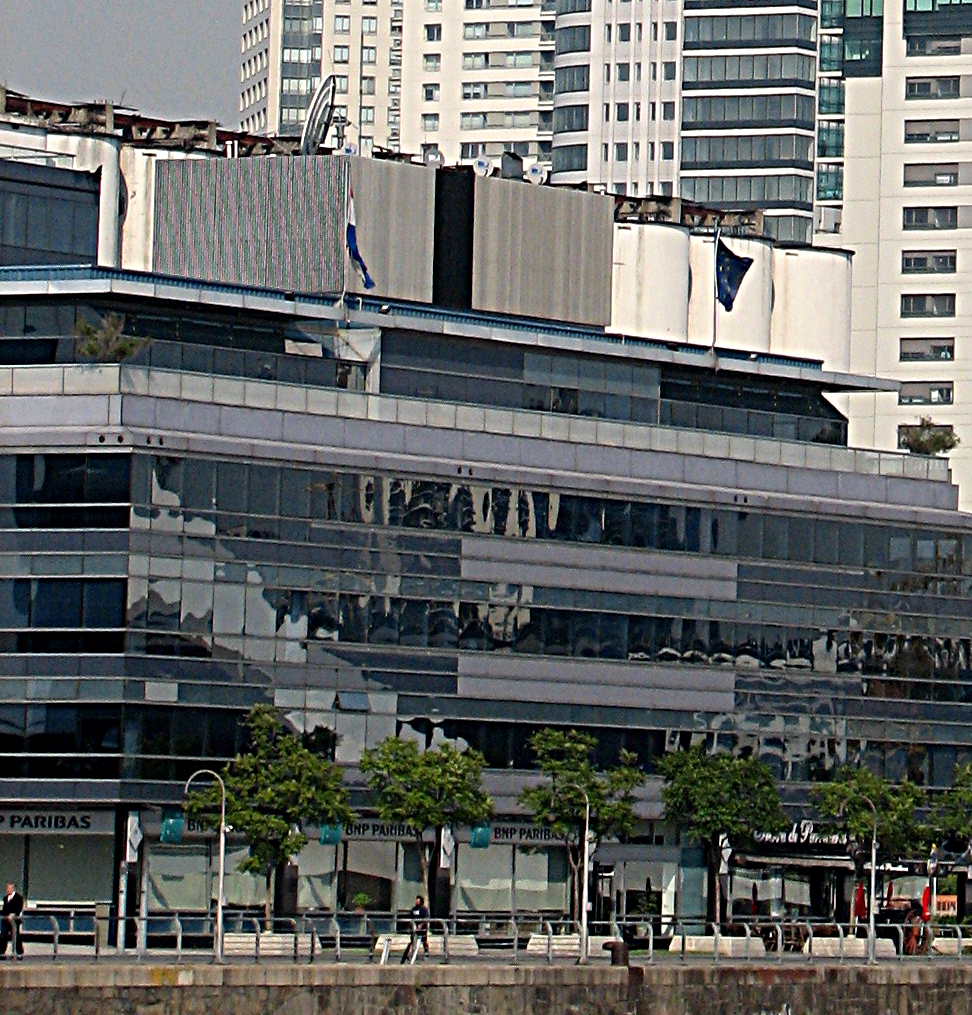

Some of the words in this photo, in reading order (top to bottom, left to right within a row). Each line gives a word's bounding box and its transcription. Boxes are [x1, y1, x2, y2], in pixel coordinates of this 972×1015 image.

[10, 815, 91, 828] PARIBAS
[345, 823, 370, 836] BNP
[494, 827, 517, 839] BNP
